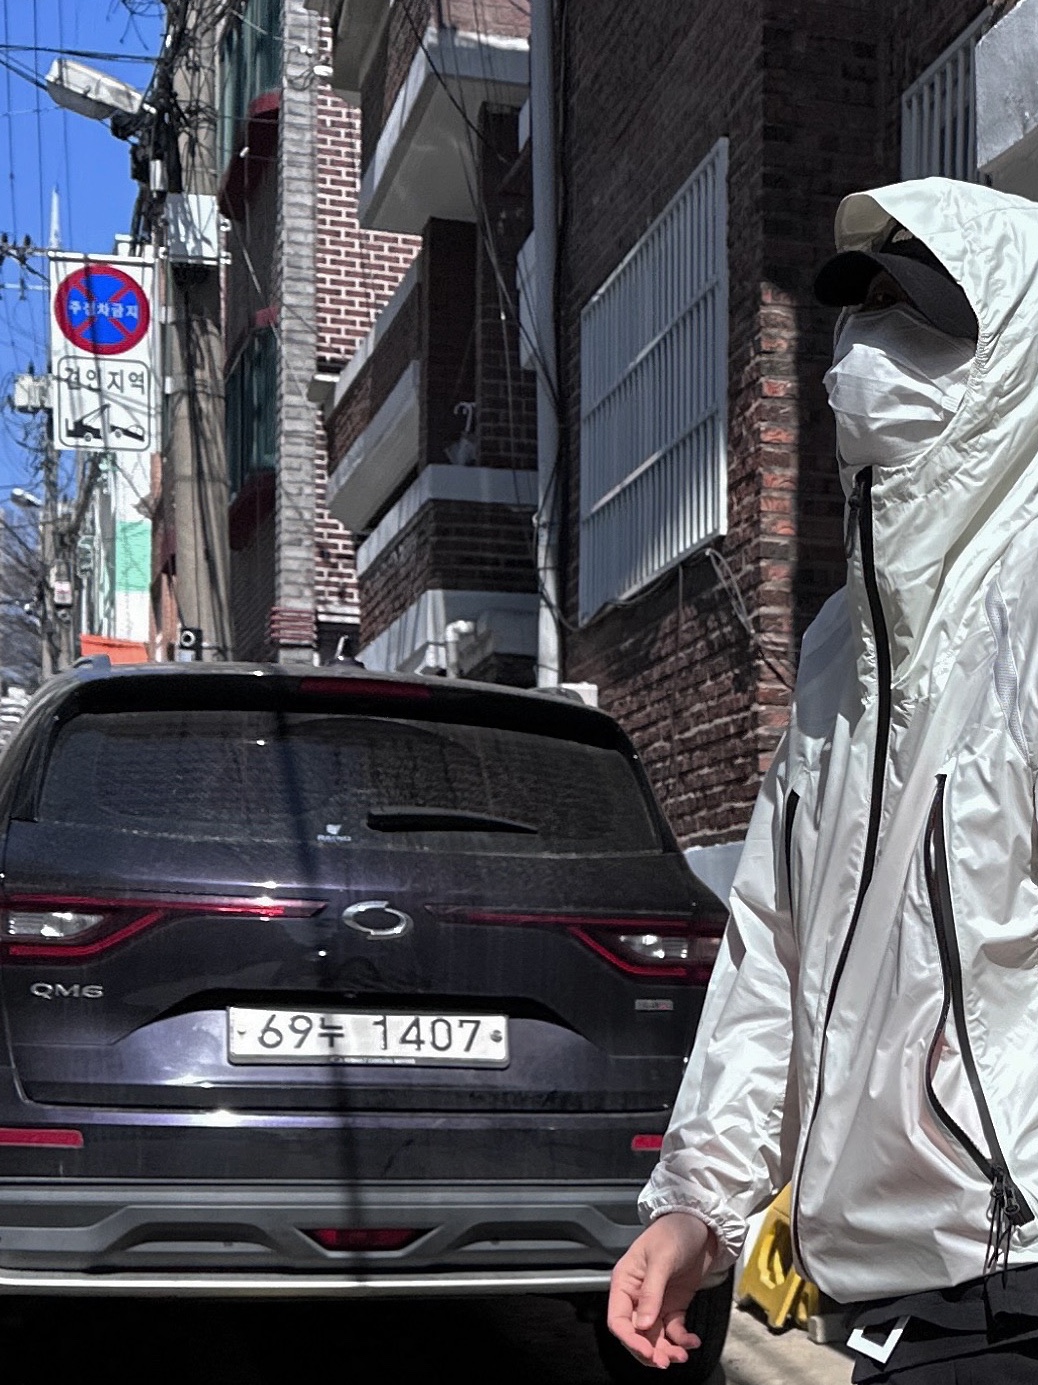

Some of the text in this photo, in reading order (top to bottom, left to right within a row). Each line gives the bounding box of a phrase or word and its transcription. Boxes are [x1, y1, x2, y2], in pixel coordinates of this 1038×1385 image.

[64, 366, 145, 395] 견인지역
[30, 982, 104, 1000] QM6
[257, 1014, 482, 1052] 69누 1407
